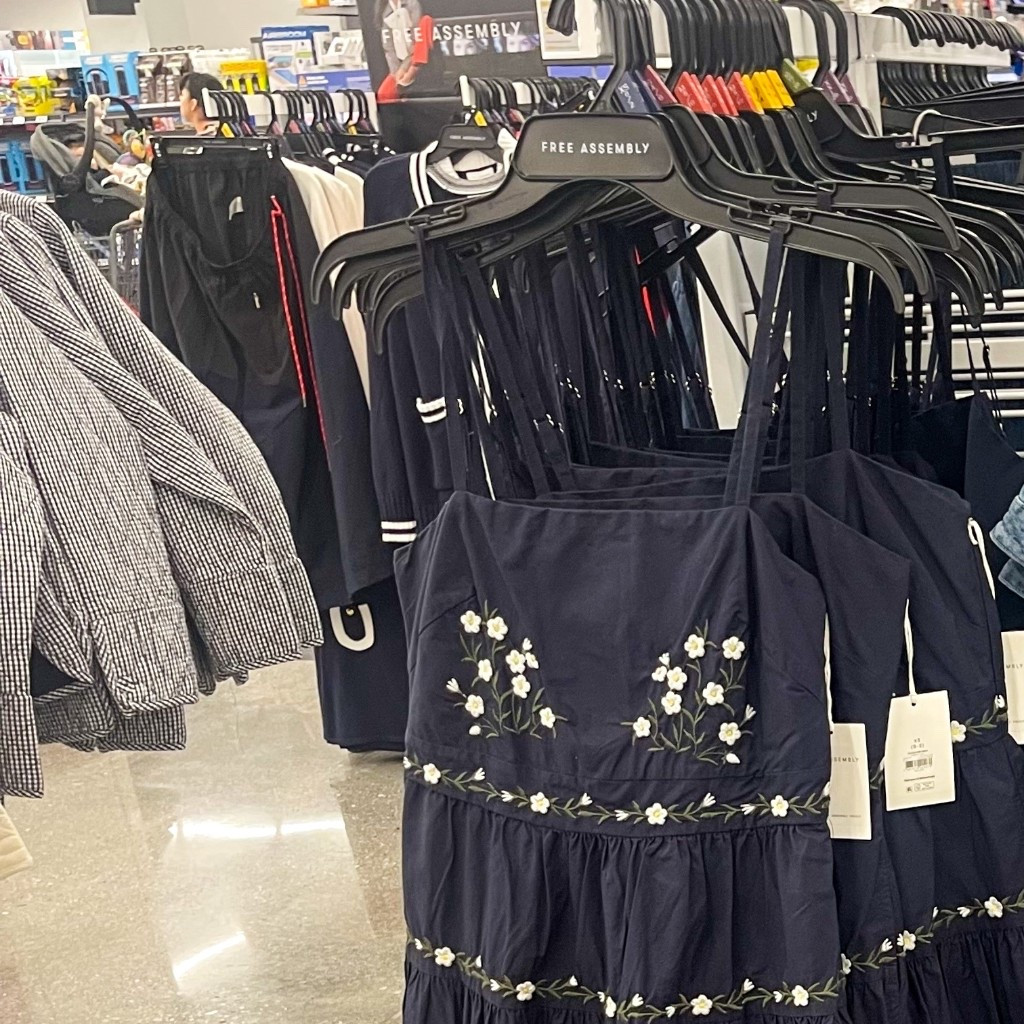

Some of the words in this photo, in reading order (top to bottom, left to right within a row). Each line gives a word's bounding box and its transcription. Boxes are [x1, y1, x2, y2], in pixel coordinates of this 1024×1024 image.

[433, 22, 521, 41] ASSEMBLY
[541, 141, 574, 153] FREE
[580, 143, 650, 154] ASSEMBLY
